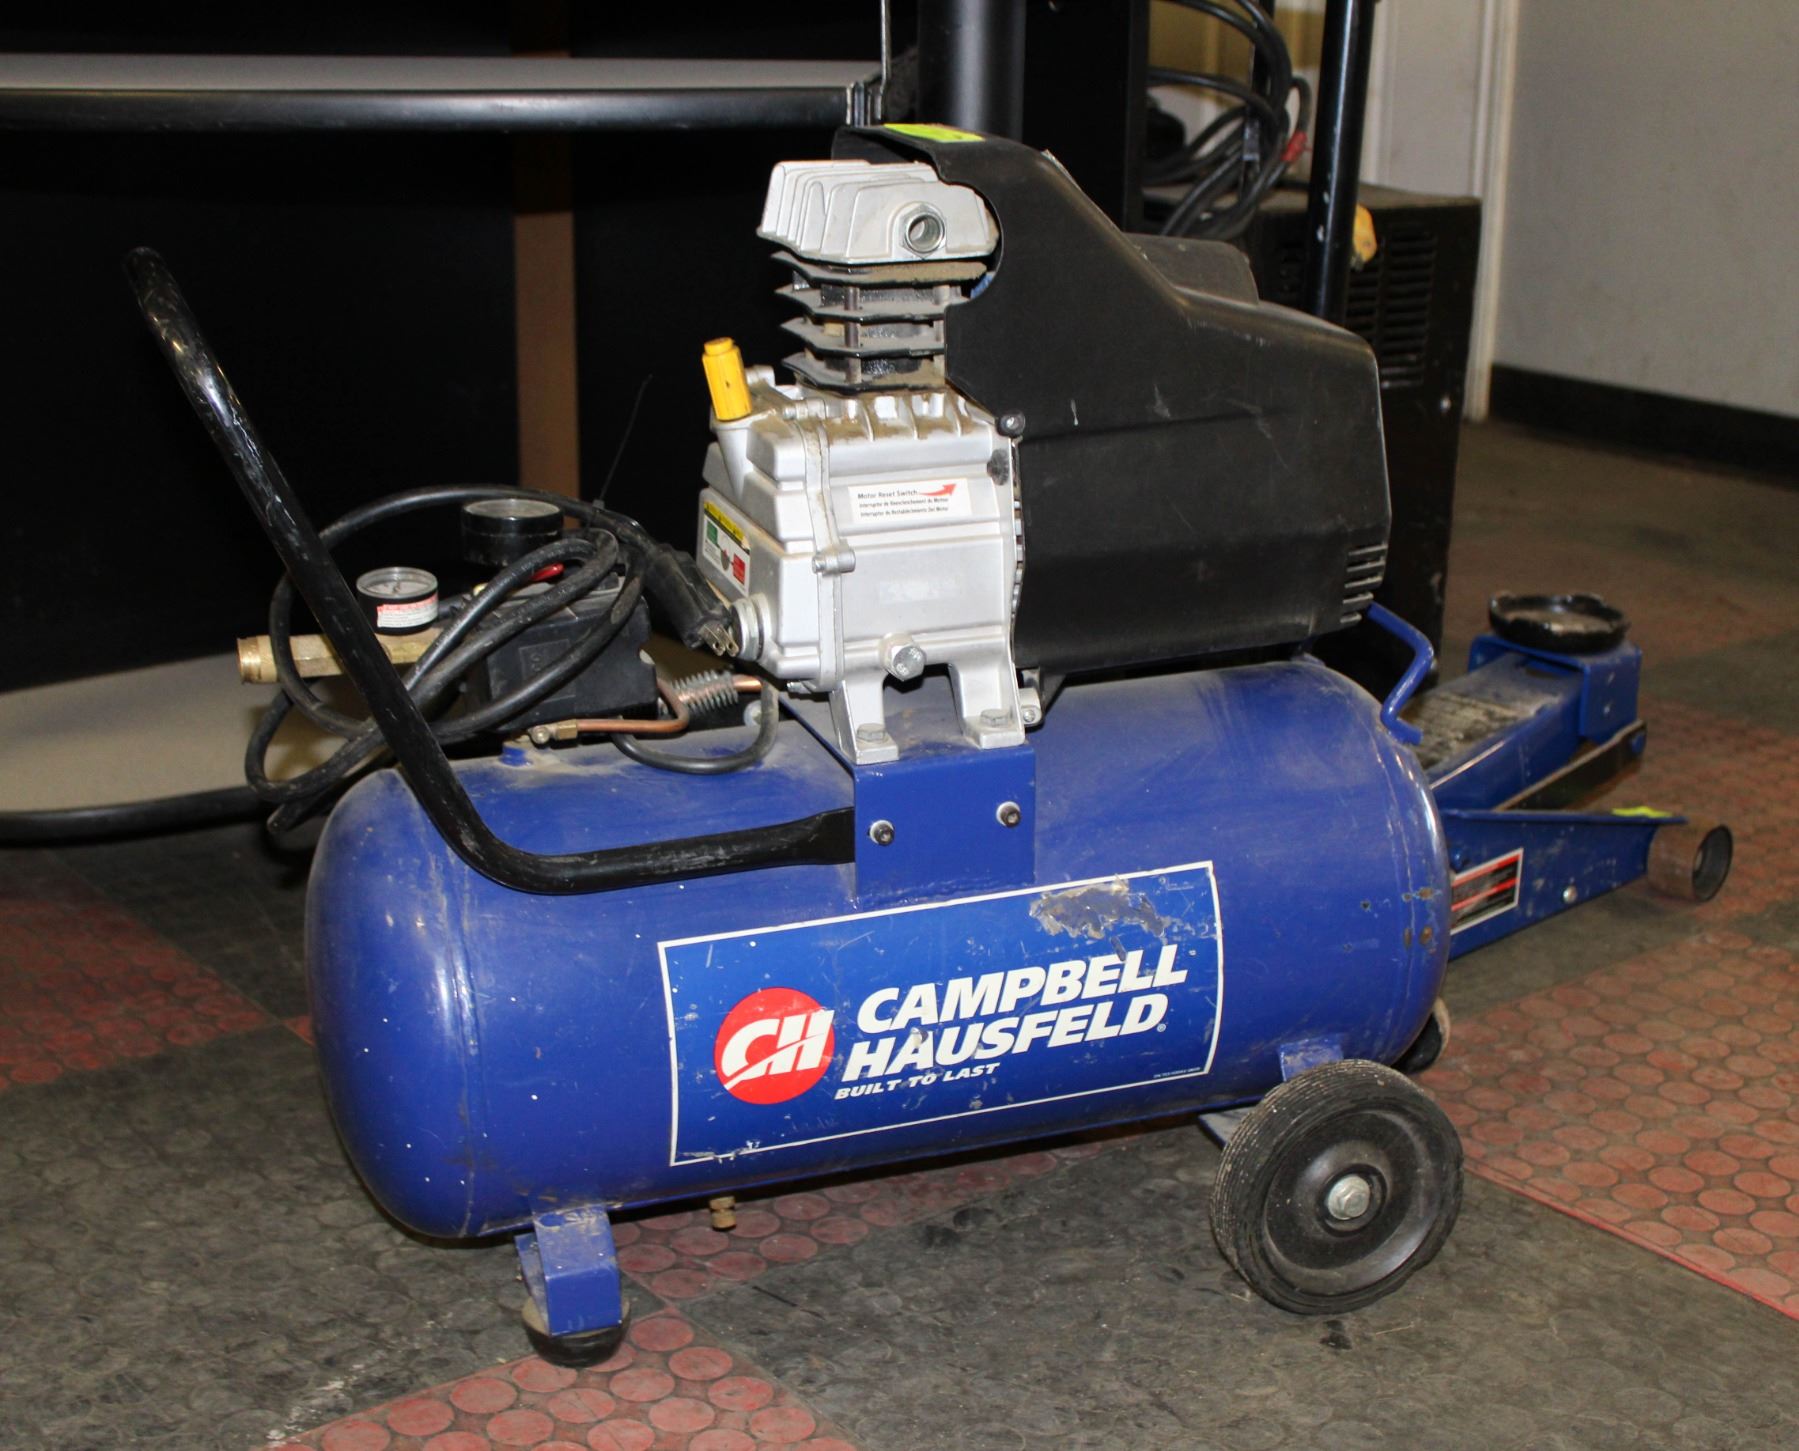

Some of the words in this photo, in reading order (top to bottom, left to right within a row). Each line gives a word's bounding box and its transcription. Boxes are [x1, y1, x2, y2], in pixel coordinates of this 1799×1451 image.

[897, 489, 918, 497] Switch
[856, 944, 1188, 1035] CAMPBELL
[834, 1079, 902, 1100] BUILT
[909, 1073, 937, 1088] TO
[942, 1062, 1001, 1082] LAST
